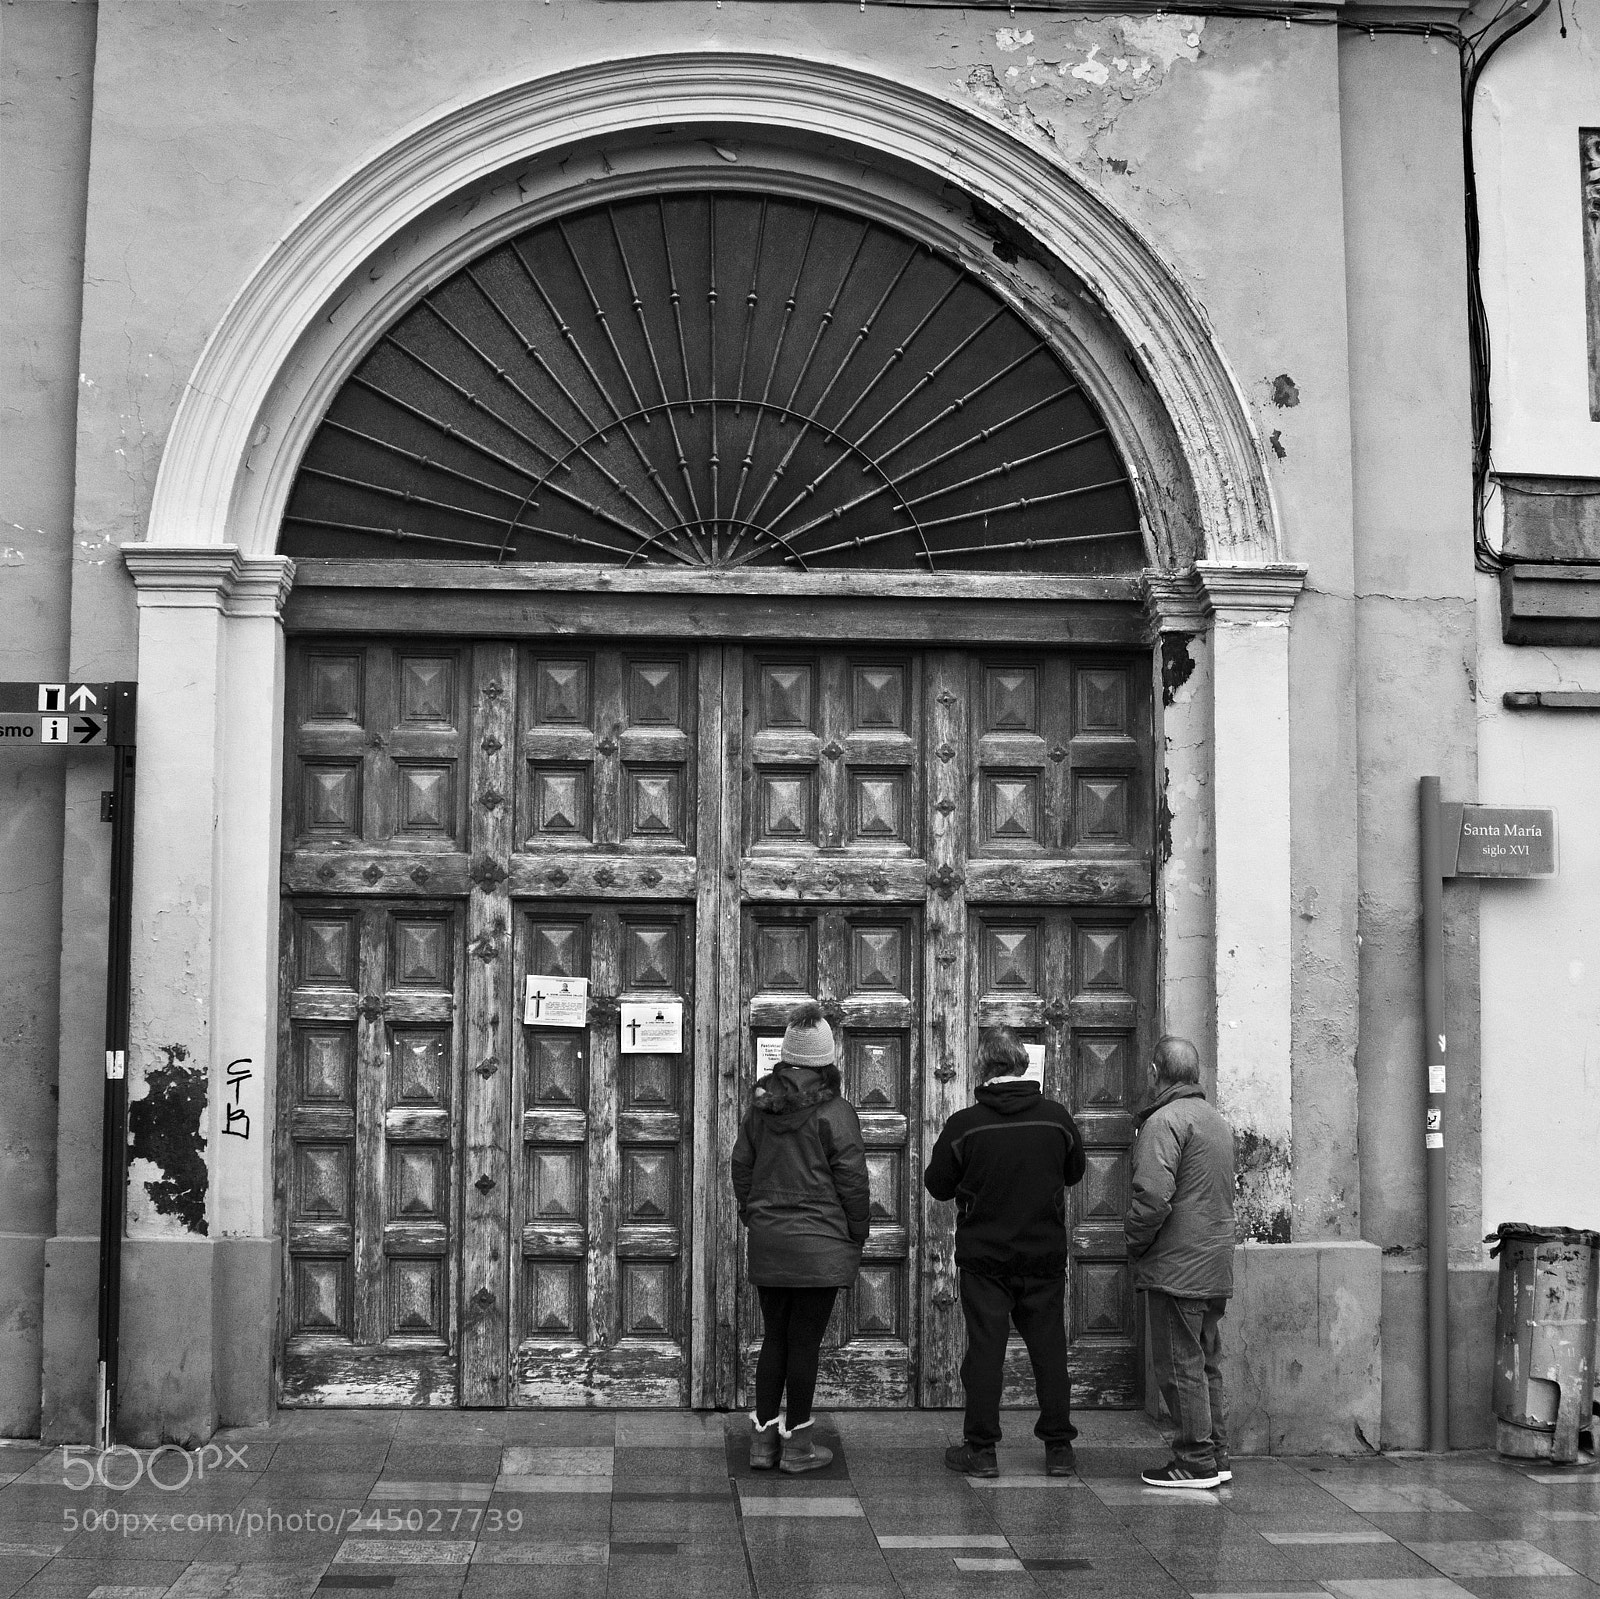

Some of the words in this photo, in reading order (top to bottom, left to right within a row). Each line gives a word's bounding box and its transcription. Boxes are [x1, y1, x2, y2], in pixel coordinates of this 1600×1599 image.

[1464, 823, 1500, 836] Santa
[1504, 823, 1542, 837] María
[1482, 844, 1507, 857] siglo
[1509, 845, 1530, 855] XVI
